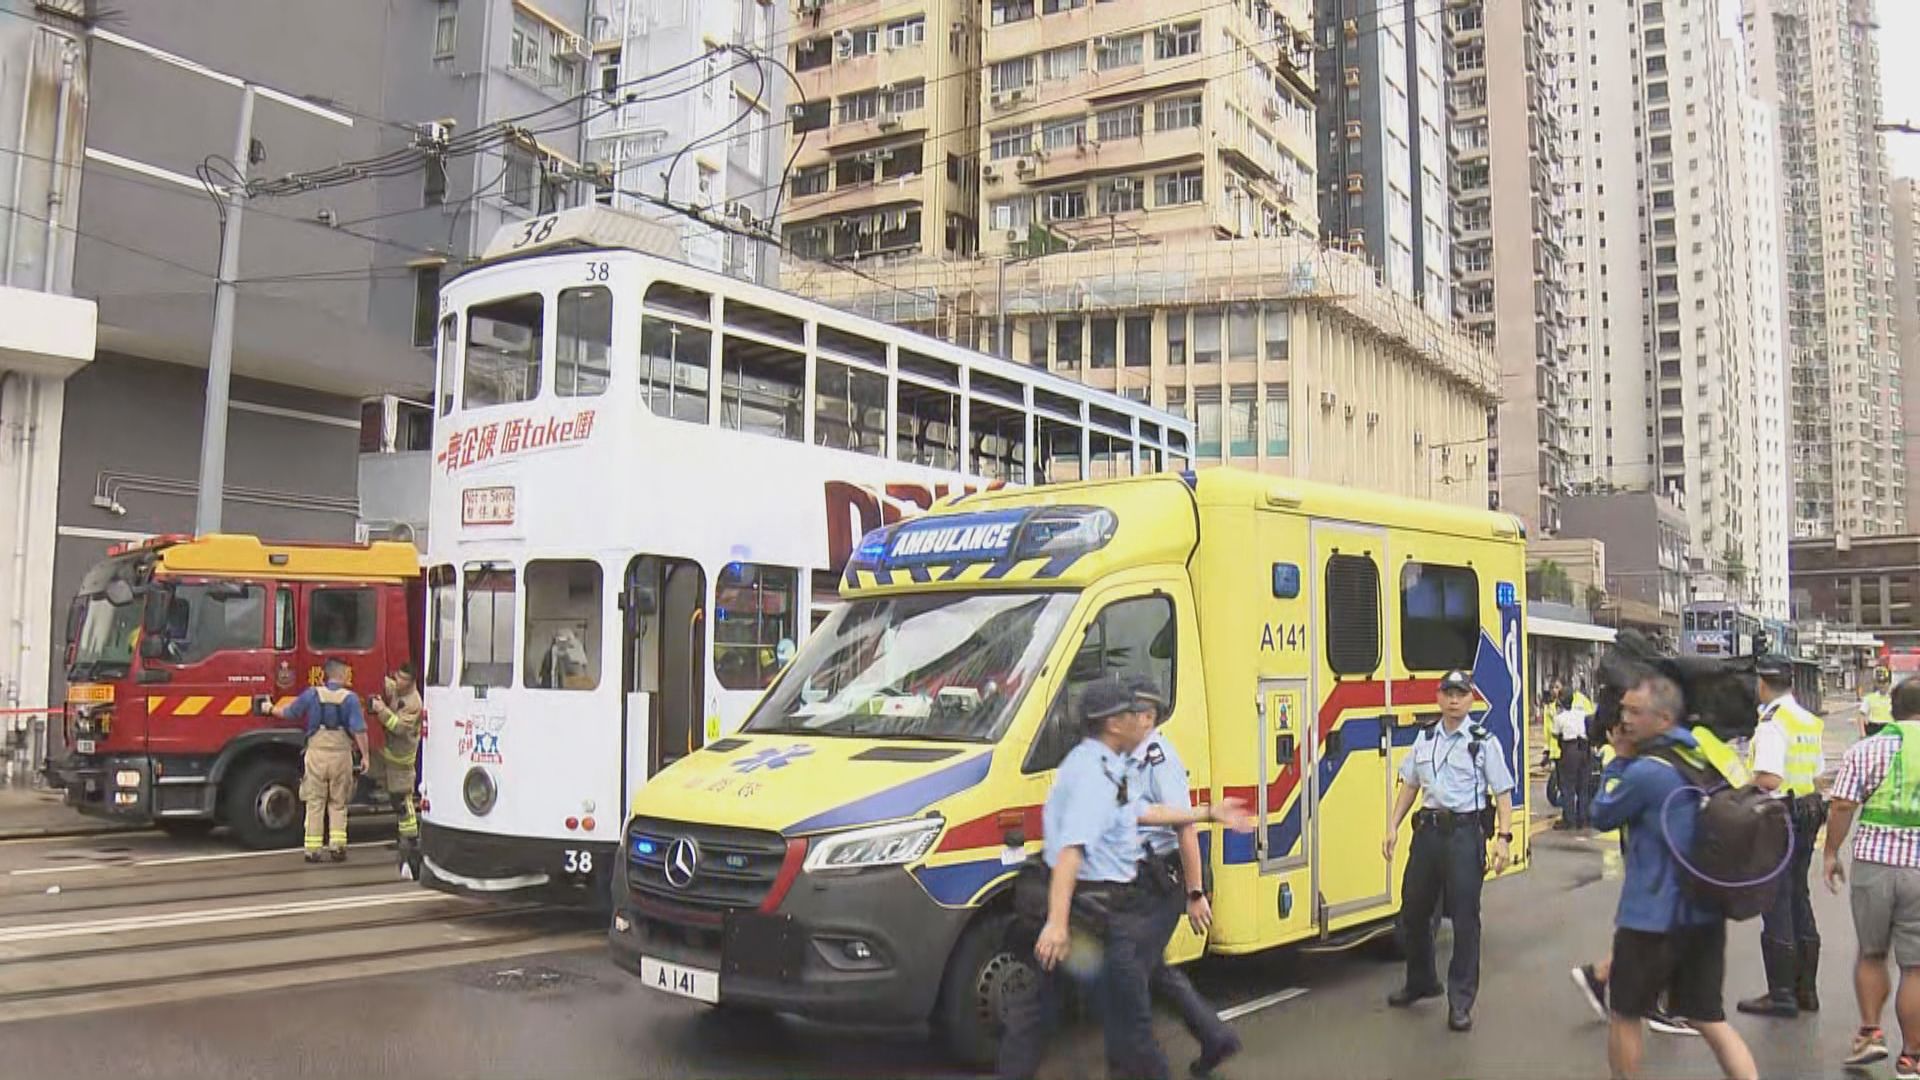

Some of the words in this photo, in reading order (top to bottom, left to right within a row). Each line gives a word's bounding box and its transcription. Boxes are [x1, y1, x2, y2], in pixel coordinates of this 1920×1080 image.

[512, 215, 559, 249] 38
[585, 261, 610, 282] 38
[891, 522, 1018, 558] AMBULANCE
[1260, 622, 1306, 652] A141
[564, 849, 593, 874] 38
[657, 965, 668, 988] A
[673, 968, 695, 994] 141
